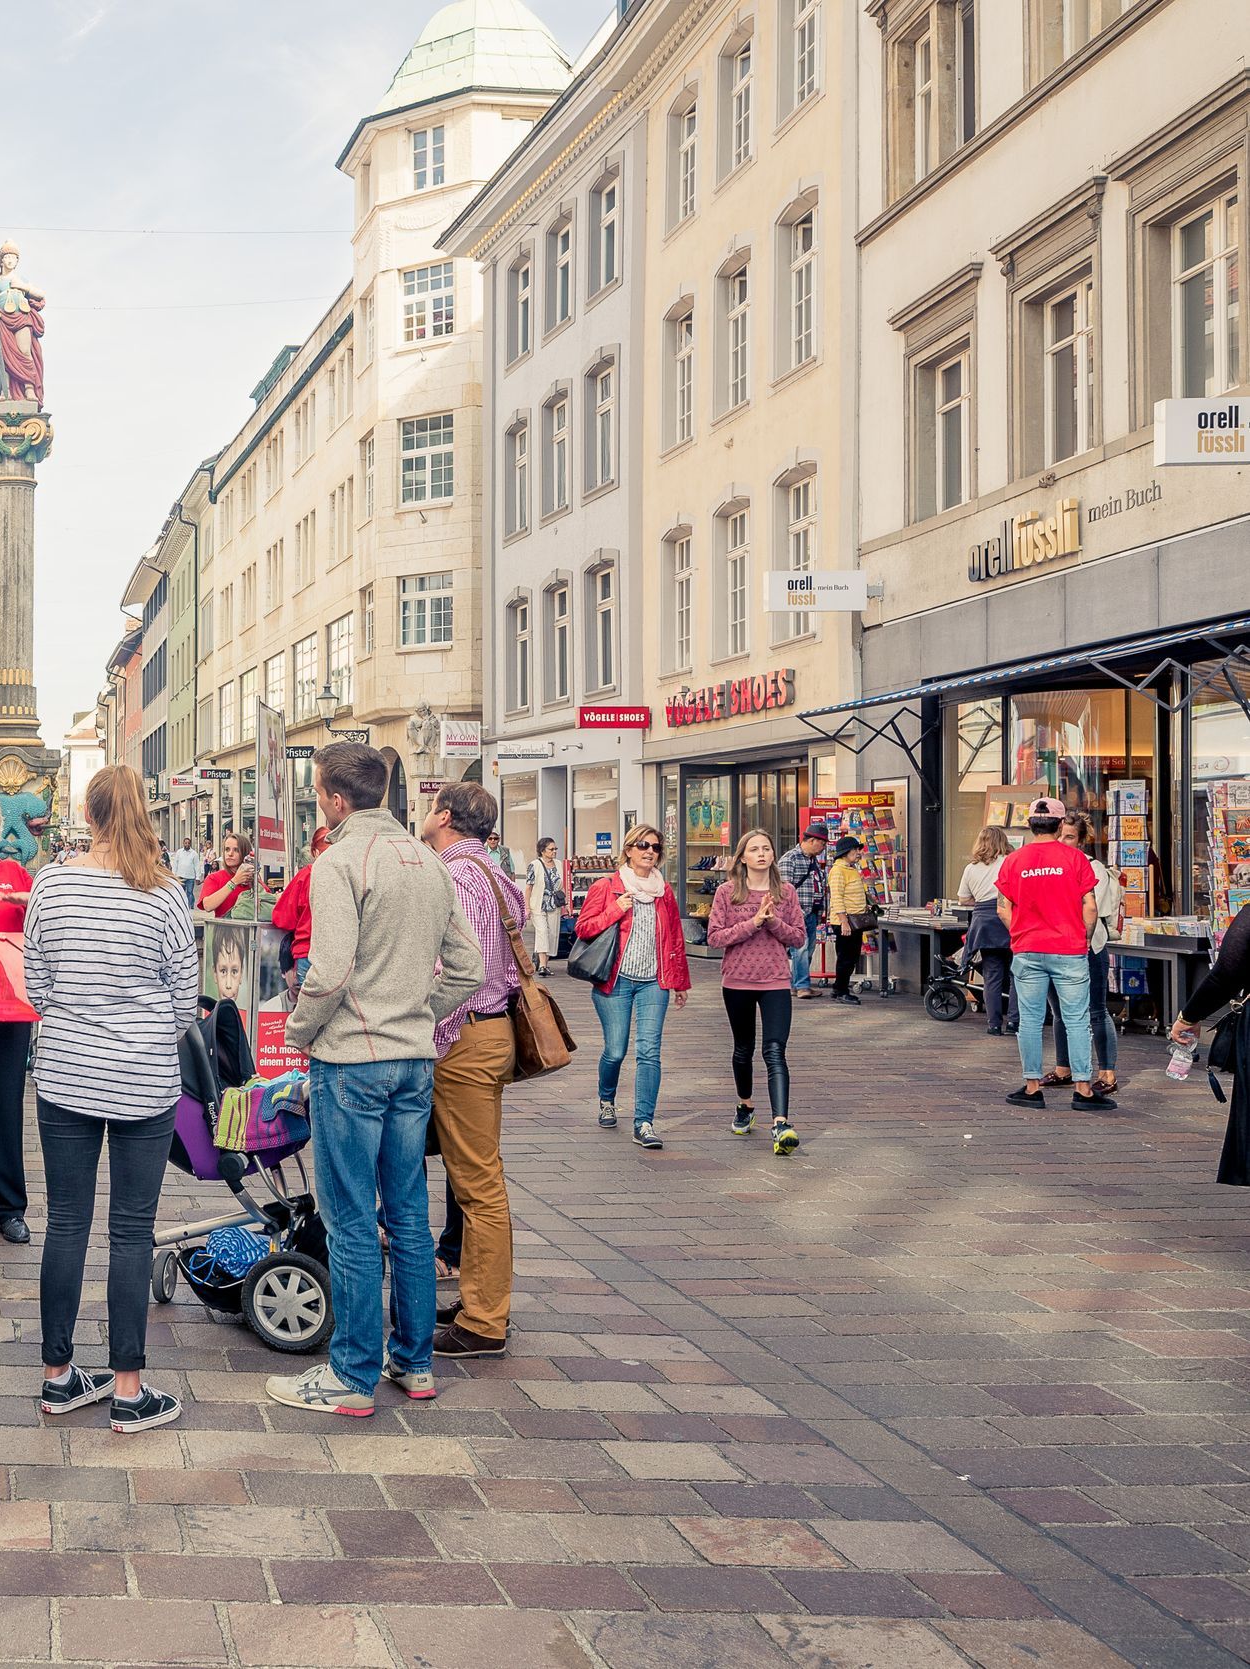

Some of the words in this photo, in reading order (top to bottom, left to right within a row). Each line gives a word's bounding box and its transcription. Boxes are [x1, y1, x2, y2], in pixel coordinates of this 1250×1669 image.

[1087, 496, 1123, 524] mein
[1125, 480, 1163, 511] Buch
[664, 683, 722, 728] VÖGELE
[730, 667, 791, 716] SHOES
[583, 711, 616, 722] VÖGELE
[619, 712, 645, 722] SHOES
[206, 769, 229, 778] Pfister
[1021, 866, 1063, 878] CARITAS
[260, 1045, 277, 1054] «Ich
[260, 1057, 284, 1066] einem
[285, 1057, 301, 1066] Bett
